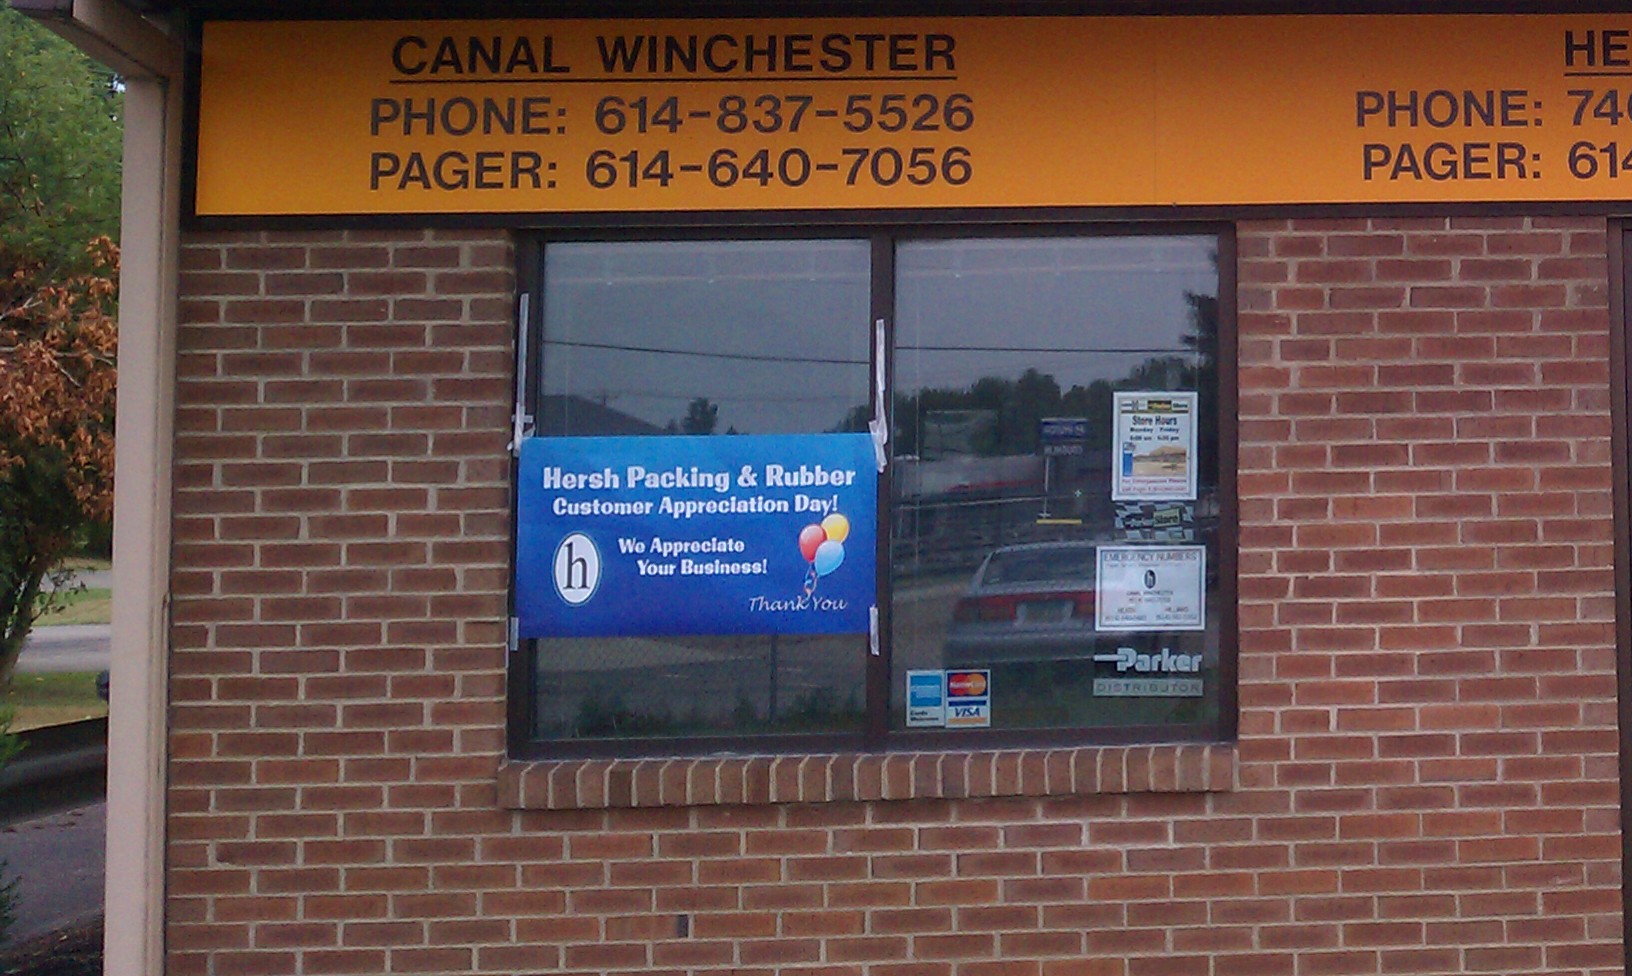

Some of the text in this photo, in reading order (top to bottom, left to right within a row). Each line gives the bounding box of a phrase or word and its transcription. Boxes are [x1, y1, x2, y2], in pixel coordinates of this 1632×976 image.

[391, 32, 958, 76] CANAL WINCHESTER
[369, 92, 975, 136] PHONE: 614-837-5526
[1355, 88, 1544, 129] PHONE:
[369, 145, 974, 191] PAGER: 614-640-7056
[1362, 140, 1542, 181] PAGER:
[1131, 414, 1178, 426] Store Hours
[543, 464, 856, 493] Hersh Packing & Rubber
[552, 493, 839, 518] Customer Appreciation Day!
[618, 536, 746, 558] We Appreciate
[1104, 551, 1198, 562] EMERGENCY NUMBERS
[562, 541, 590, 590] h
[637, 557, 768, 576] Your Business!
[749, 594, 848, 612] Thank You
[1116, 647, 1203, 673] Parker
[1097, 682, 1200, 693] DISTRIBUTOR
[954, 707, 981, 717] VISA
